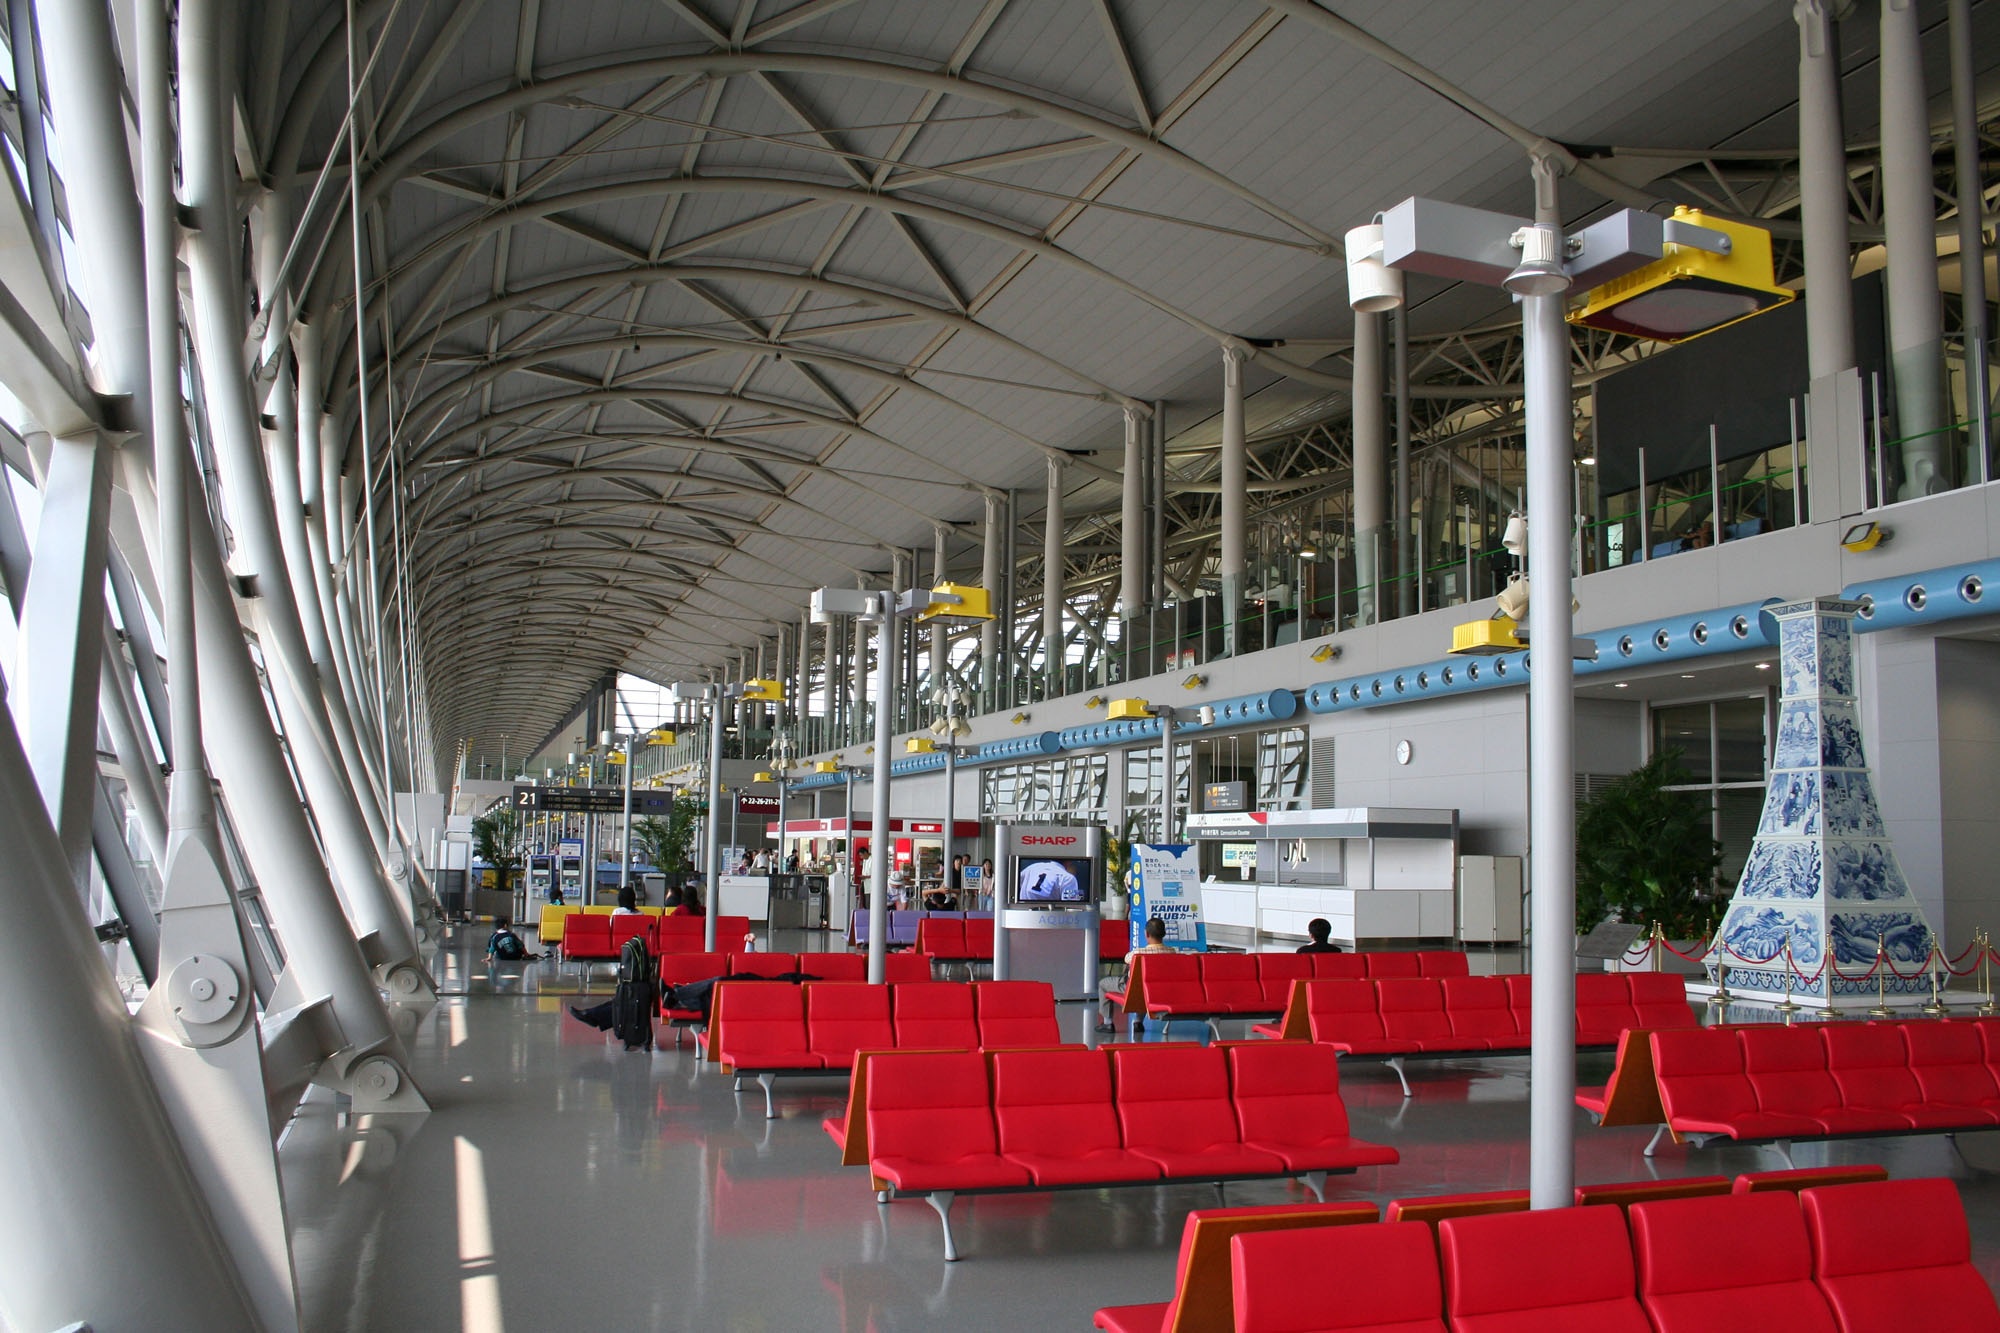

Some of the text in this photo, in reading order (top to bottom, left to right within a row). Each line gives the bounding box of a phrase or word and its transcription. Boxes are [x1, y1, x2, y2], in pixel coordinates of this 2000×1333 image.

[519, 792, 536, 805] 21
[1021, 836, 1077, 845] SHARP
[1283, 840, 1309, 868] JAL
[1031, 873, 1047, 891] 1
[1151, 904, 1190, 912] KANKU
[1038, 914, 1080, 925] AQUOS
